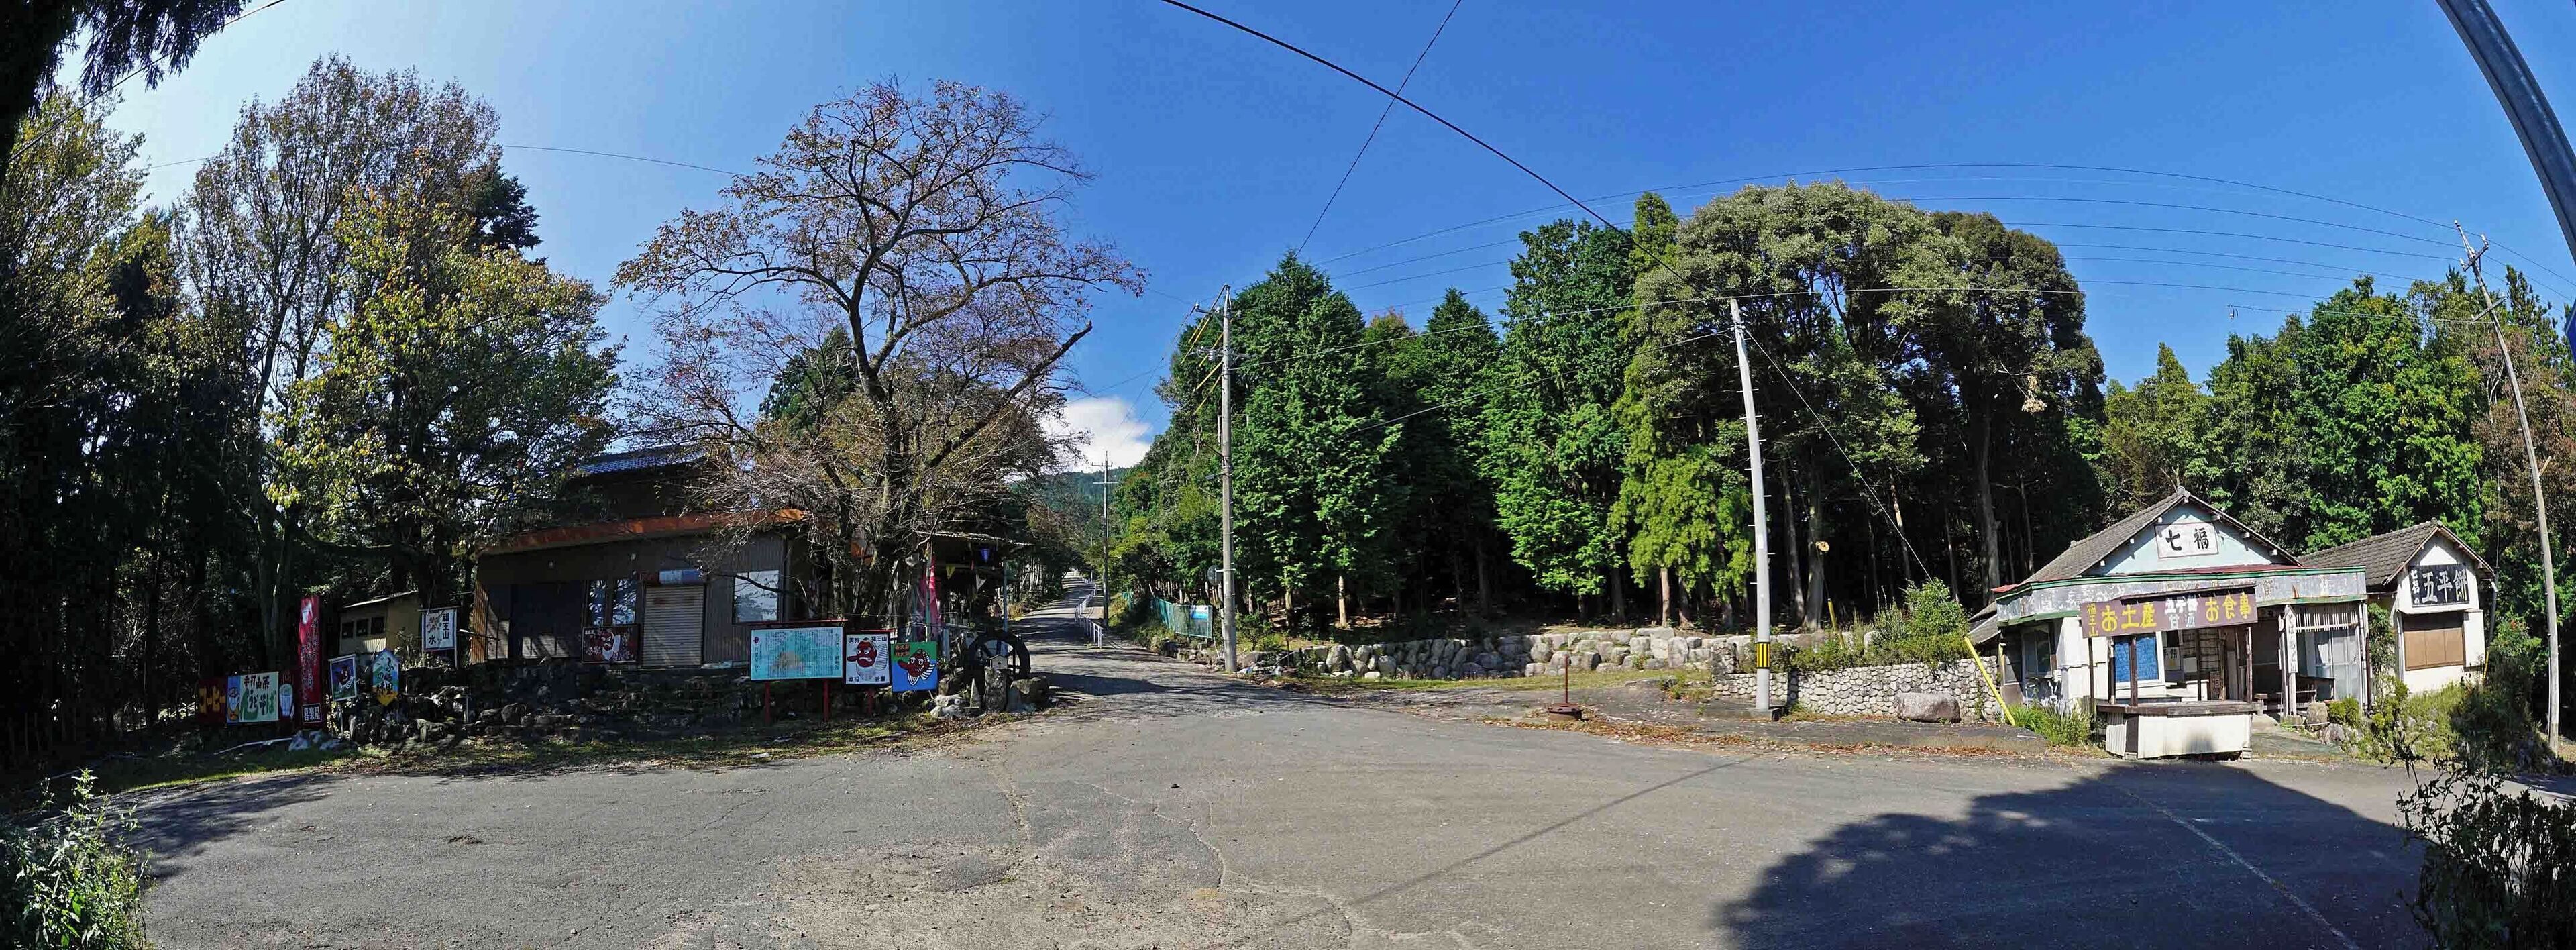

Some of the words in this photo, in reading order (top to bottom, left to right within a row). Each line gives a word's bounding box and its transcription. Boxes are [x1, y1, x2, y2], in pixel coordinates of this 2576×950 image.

[2166, 527, 2209, 551] 七福
[2422, 568, 2467, 604] 五平餅
[2086, 602, 2098, 637] 福王山
[2101, 602, 2157, 632] お土産
[2205, 592, 2251, 622] お食事
